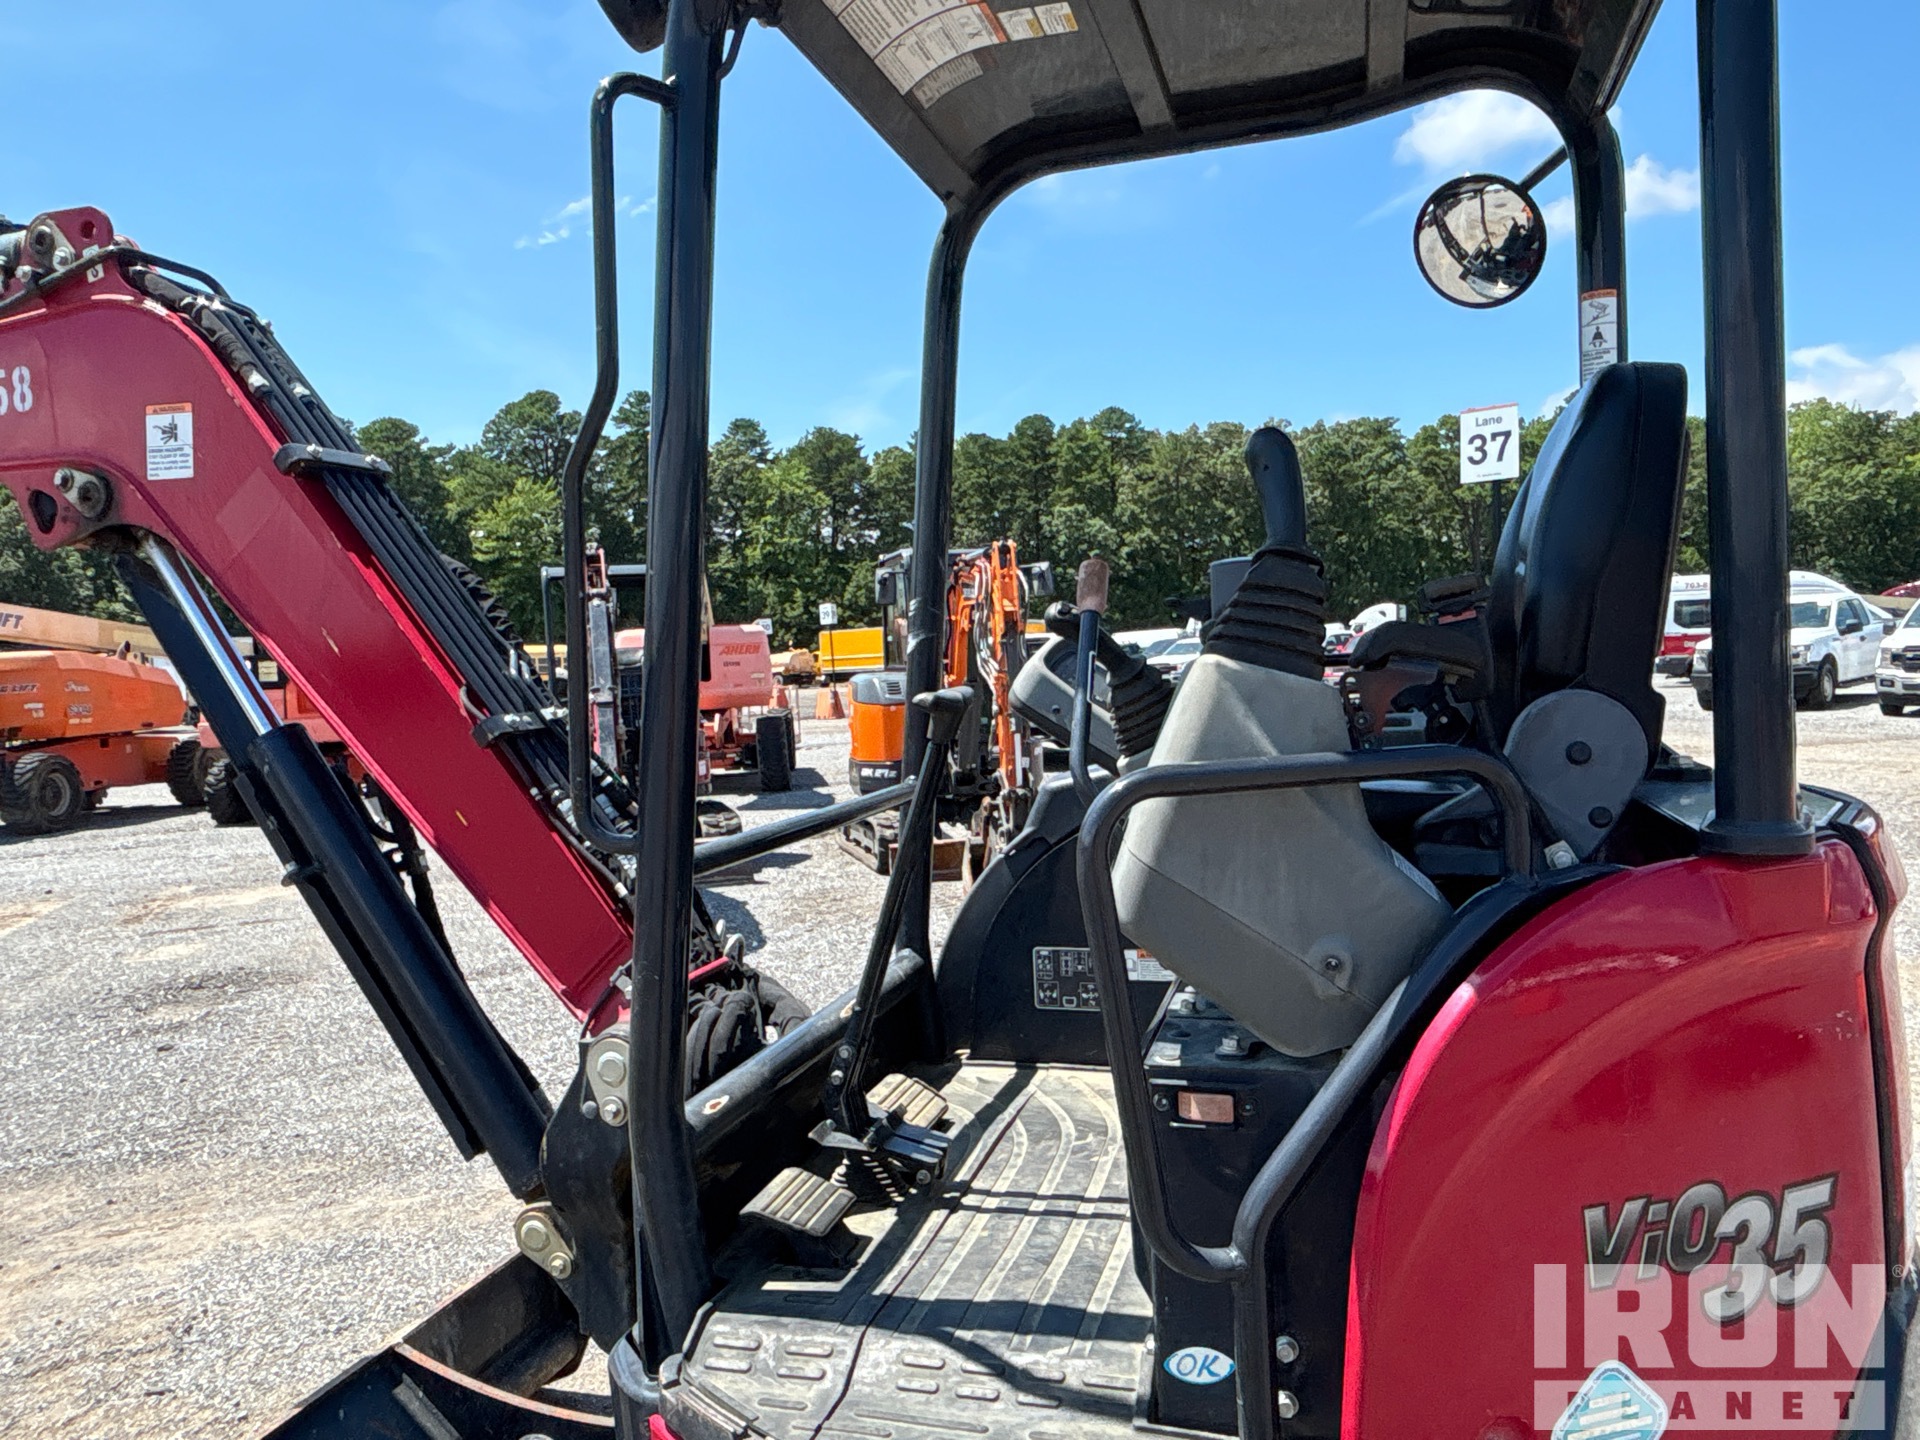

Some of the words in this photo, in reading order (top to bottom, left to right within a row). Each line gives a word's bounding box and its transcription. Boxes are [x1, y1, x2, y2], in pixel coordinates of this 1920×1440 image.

[1475, 416, 1503, 427] Lane
[1467, 430, 1512, 466] 37
[719, 643, 761, 655] AHERN
[1176, 1353, 1221, 1377] OK
